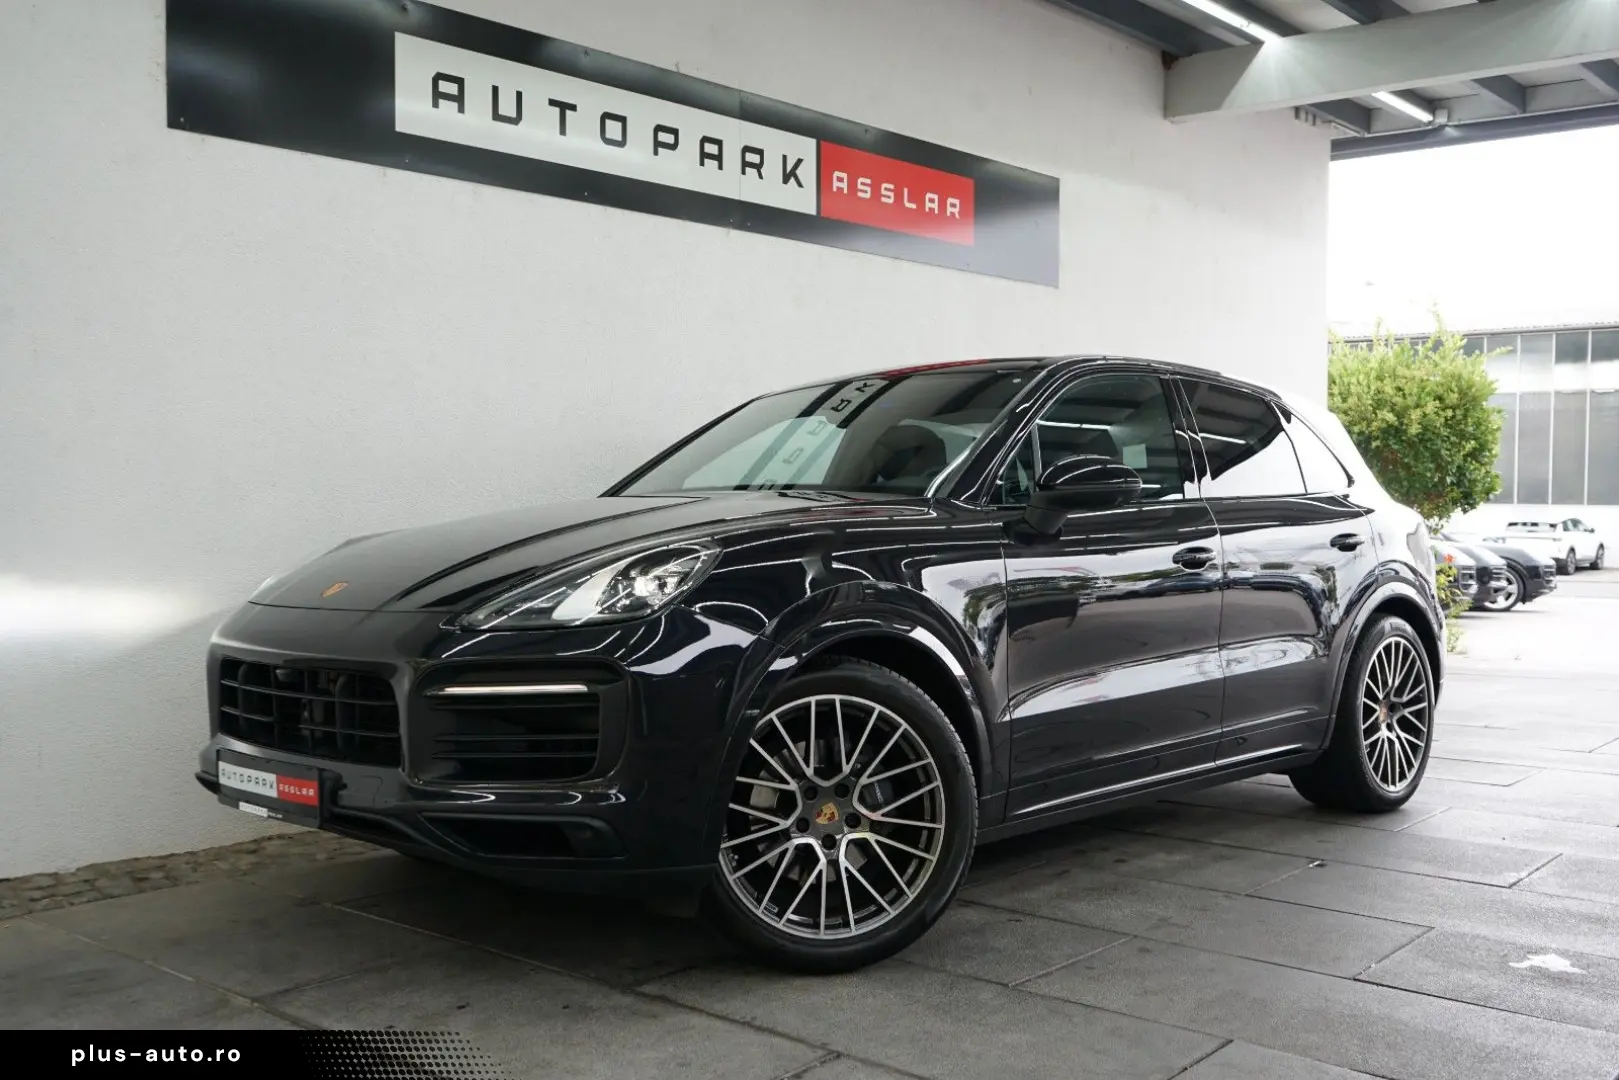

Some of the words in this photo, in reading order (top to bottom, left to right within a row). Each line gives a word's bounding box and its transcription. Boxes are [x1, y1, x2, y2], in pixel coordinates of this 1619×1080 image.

[431, 71, 805, 188] AUTOPARK
[832, 171, 961, 219] ASSLAR
[221, 768, 274, 789] AUTOPARK
[279, 783, 315, 796] ASSLAR
